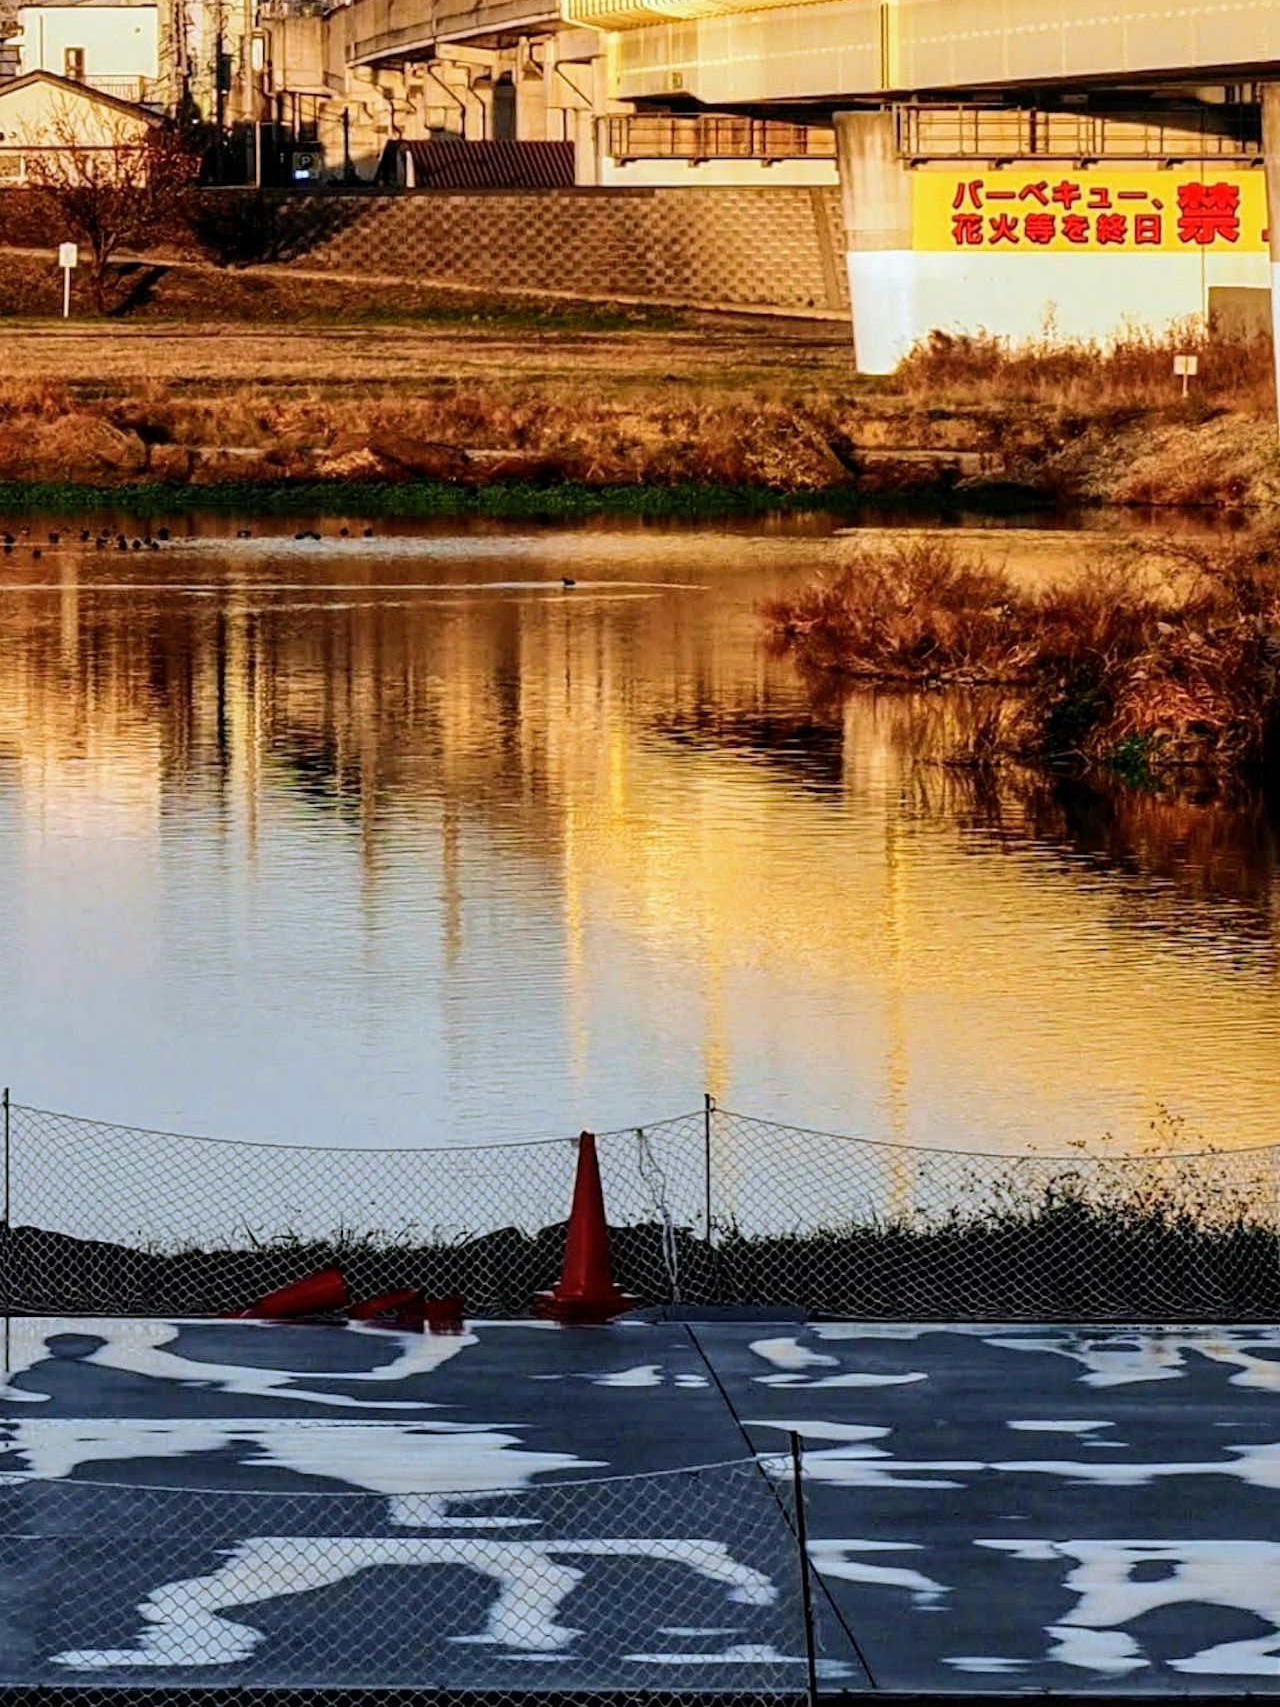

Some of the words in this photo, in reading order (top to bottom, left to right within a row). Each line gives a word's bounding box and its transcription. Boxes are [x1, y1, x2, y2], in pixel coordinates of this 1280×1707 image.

[951, 212, 1162, 245] 花火等を終日
